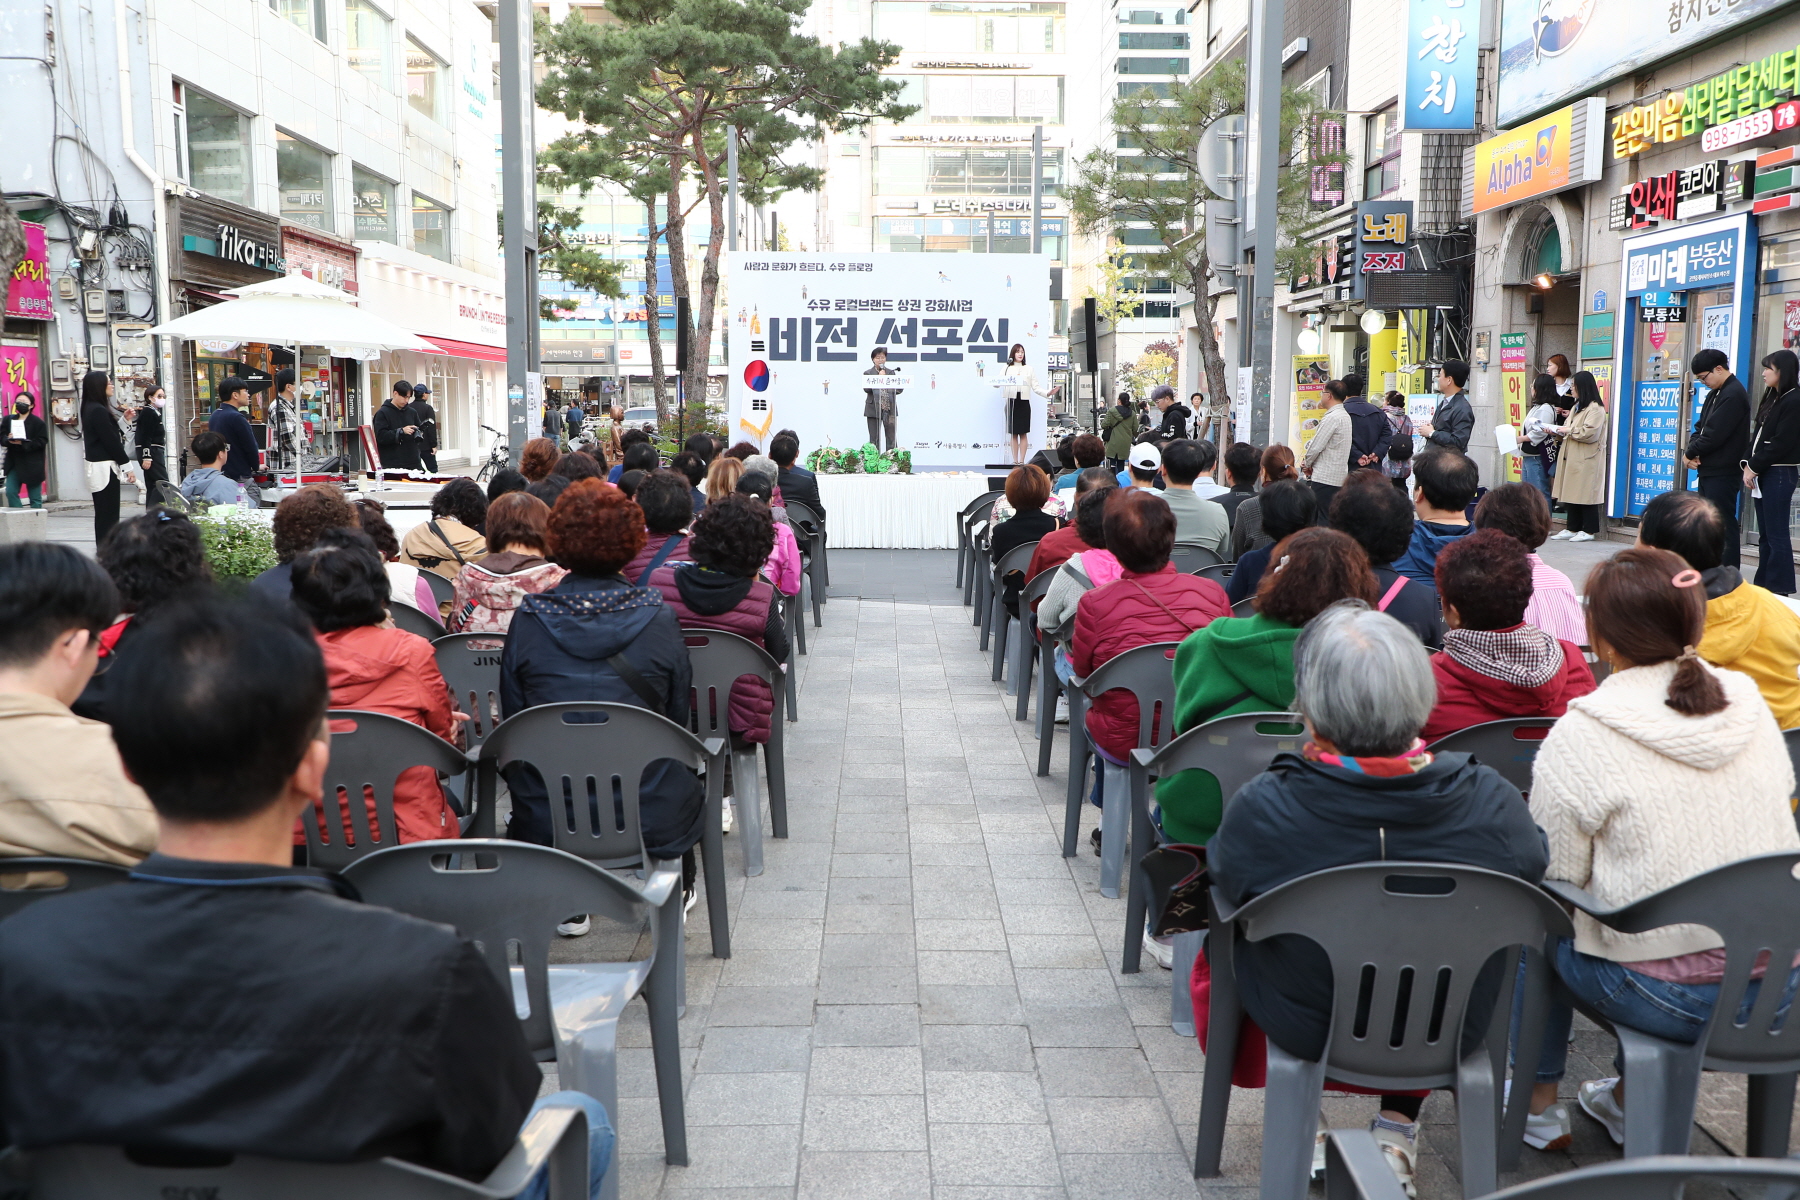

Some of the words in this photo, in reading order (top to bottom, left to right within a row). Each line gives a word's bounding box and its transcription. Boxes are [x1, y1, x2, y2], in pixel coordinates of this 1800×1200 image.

[1777, 104, 1797, 126] 7층
[1705, 113, 1769, 149] 998-7555
[1487, 153, 1532, 194] Alpha
[935, 197, 982, 213] 프레쉬
[1630, 170, 1678, 230] 인쇄
[1678, 164, 1719, 197] 코리아
[1362, 213, 1408, 244] 노래
[219, 225, 256, 265] fika
[744, 262, 770, 271] 사람과
[771, 262, 797, 271] 문화가
[829, 262, 846, 271] 수유
[848, 262, 873, 272] 플로잉
[1647, 245, 1688, 288] 미래
[1689, 238, 1733, 271] 부동산
[807, 299, 831, 312] 수유
[834, 299, 894, 312] 로컬브랜드
[898, 299, 922, 312] 상권
[925, 299, 973, 312] 강화사업
[1642, 307, 1682, 322] 부동산
[202, 340, 228, 349] Cafe
[769, 317, 858, 362] 비전
[875, 317, 1009, 363] 선포식
[1048, 354, 1068, 368] 의원
